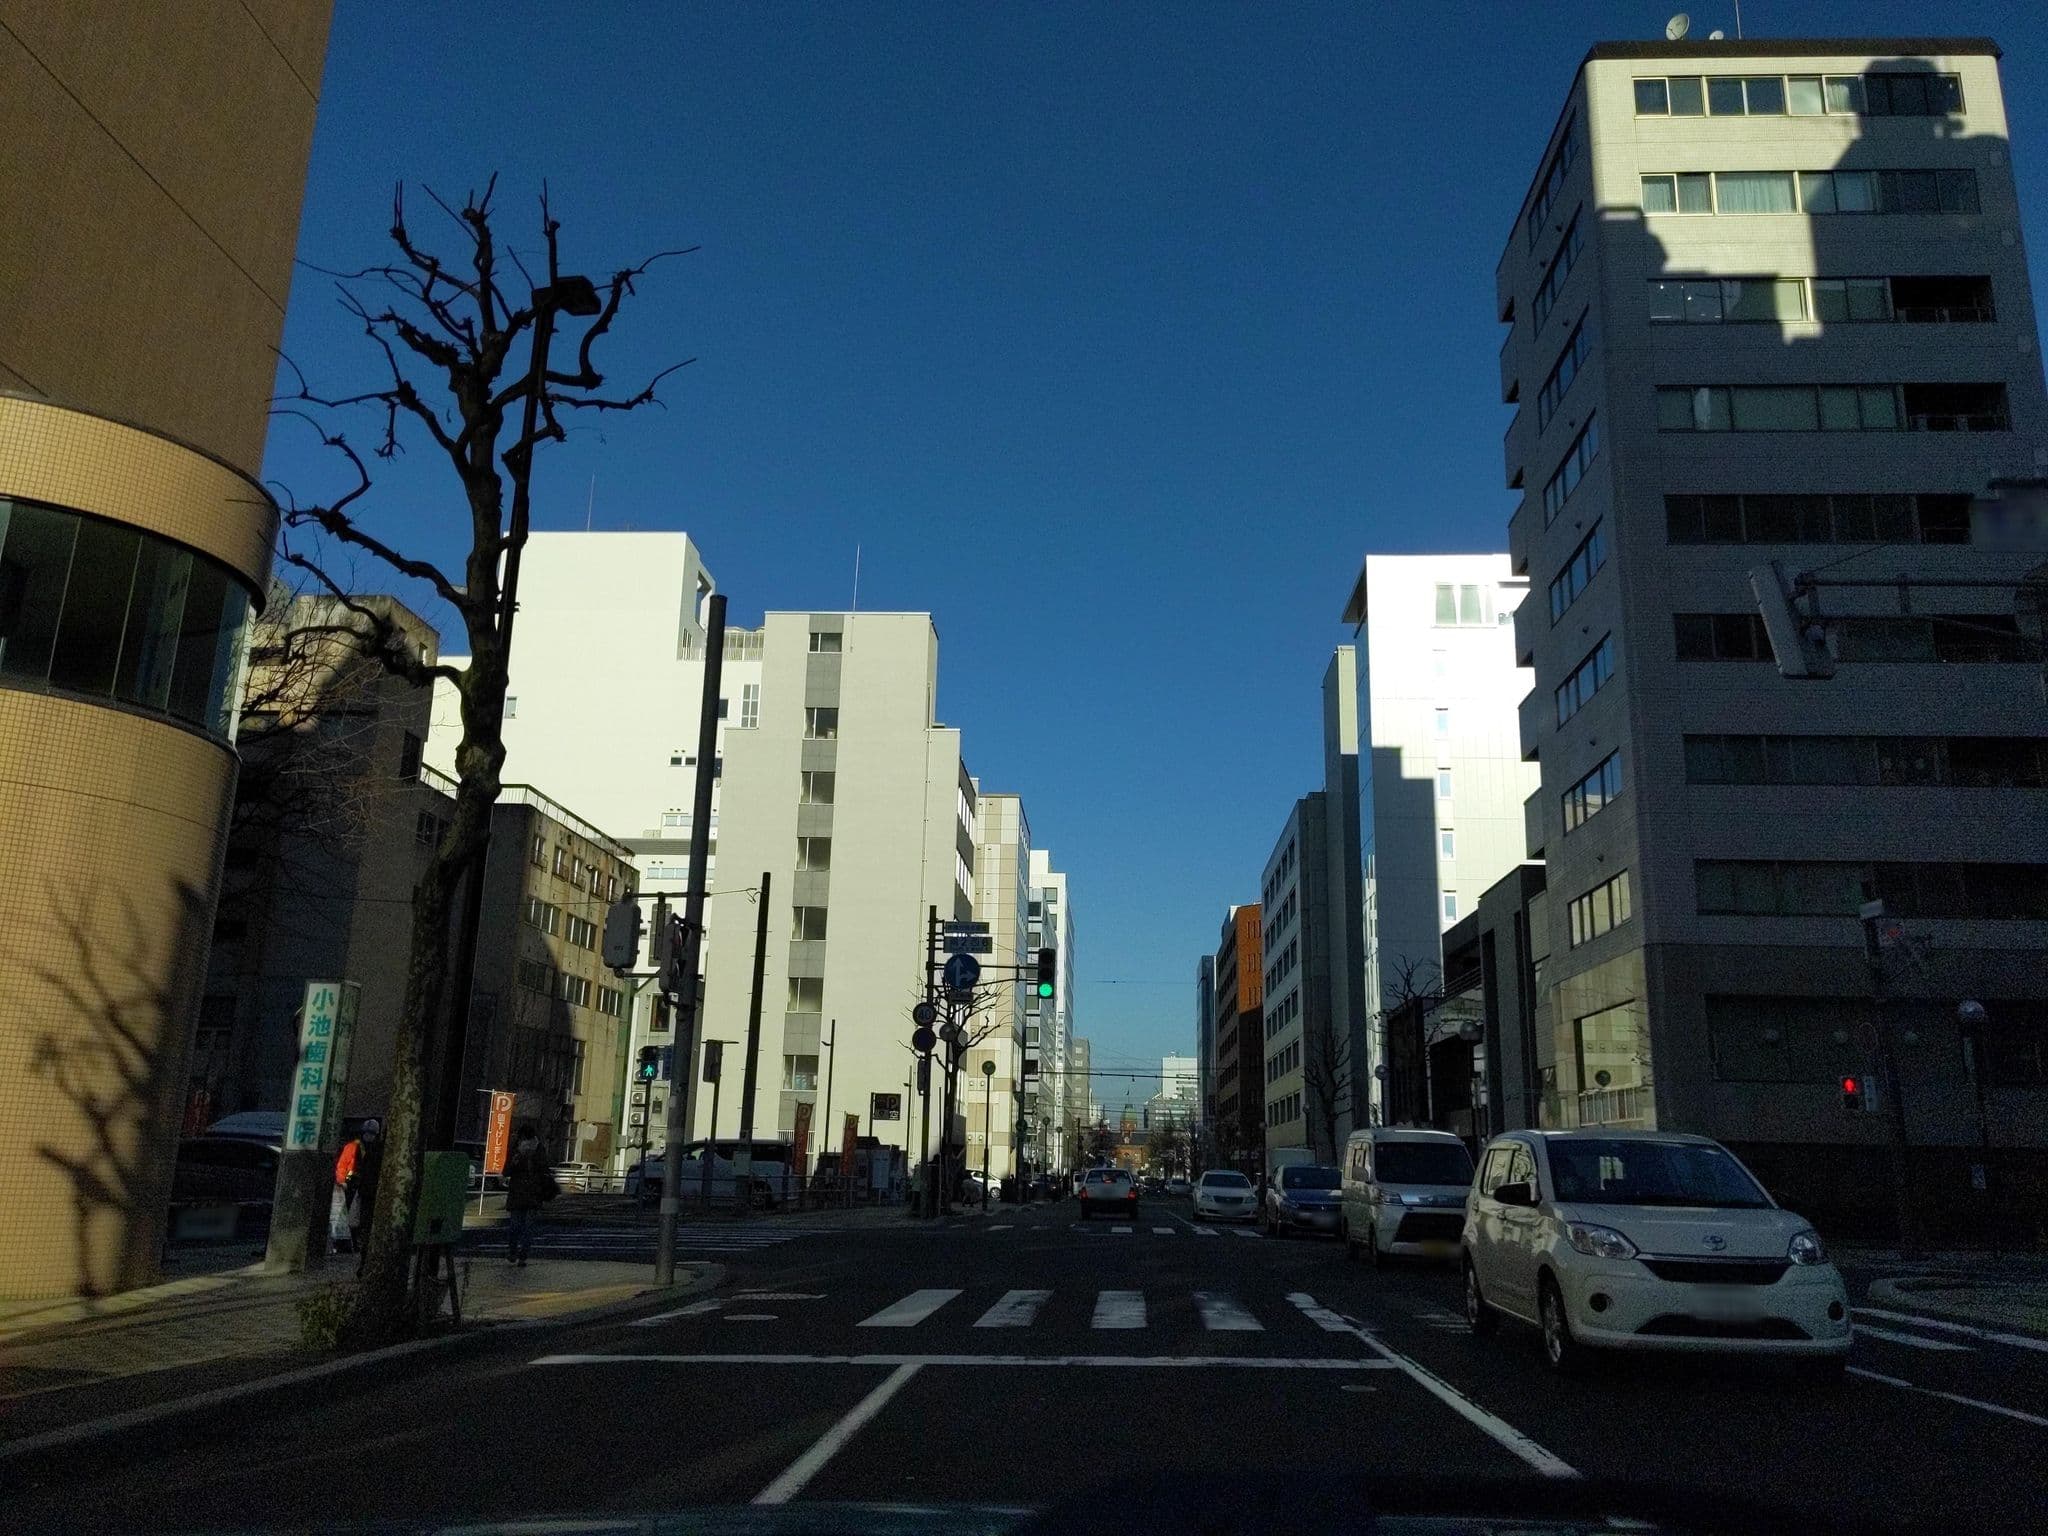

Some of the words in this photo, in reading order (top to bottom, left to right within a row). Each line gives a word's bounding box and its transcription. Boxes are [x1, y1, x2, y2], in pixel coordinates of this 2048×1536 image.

[917, 1008, 931, 1020] 40
[292, 988, 334, 1144] 小池歯科医院
